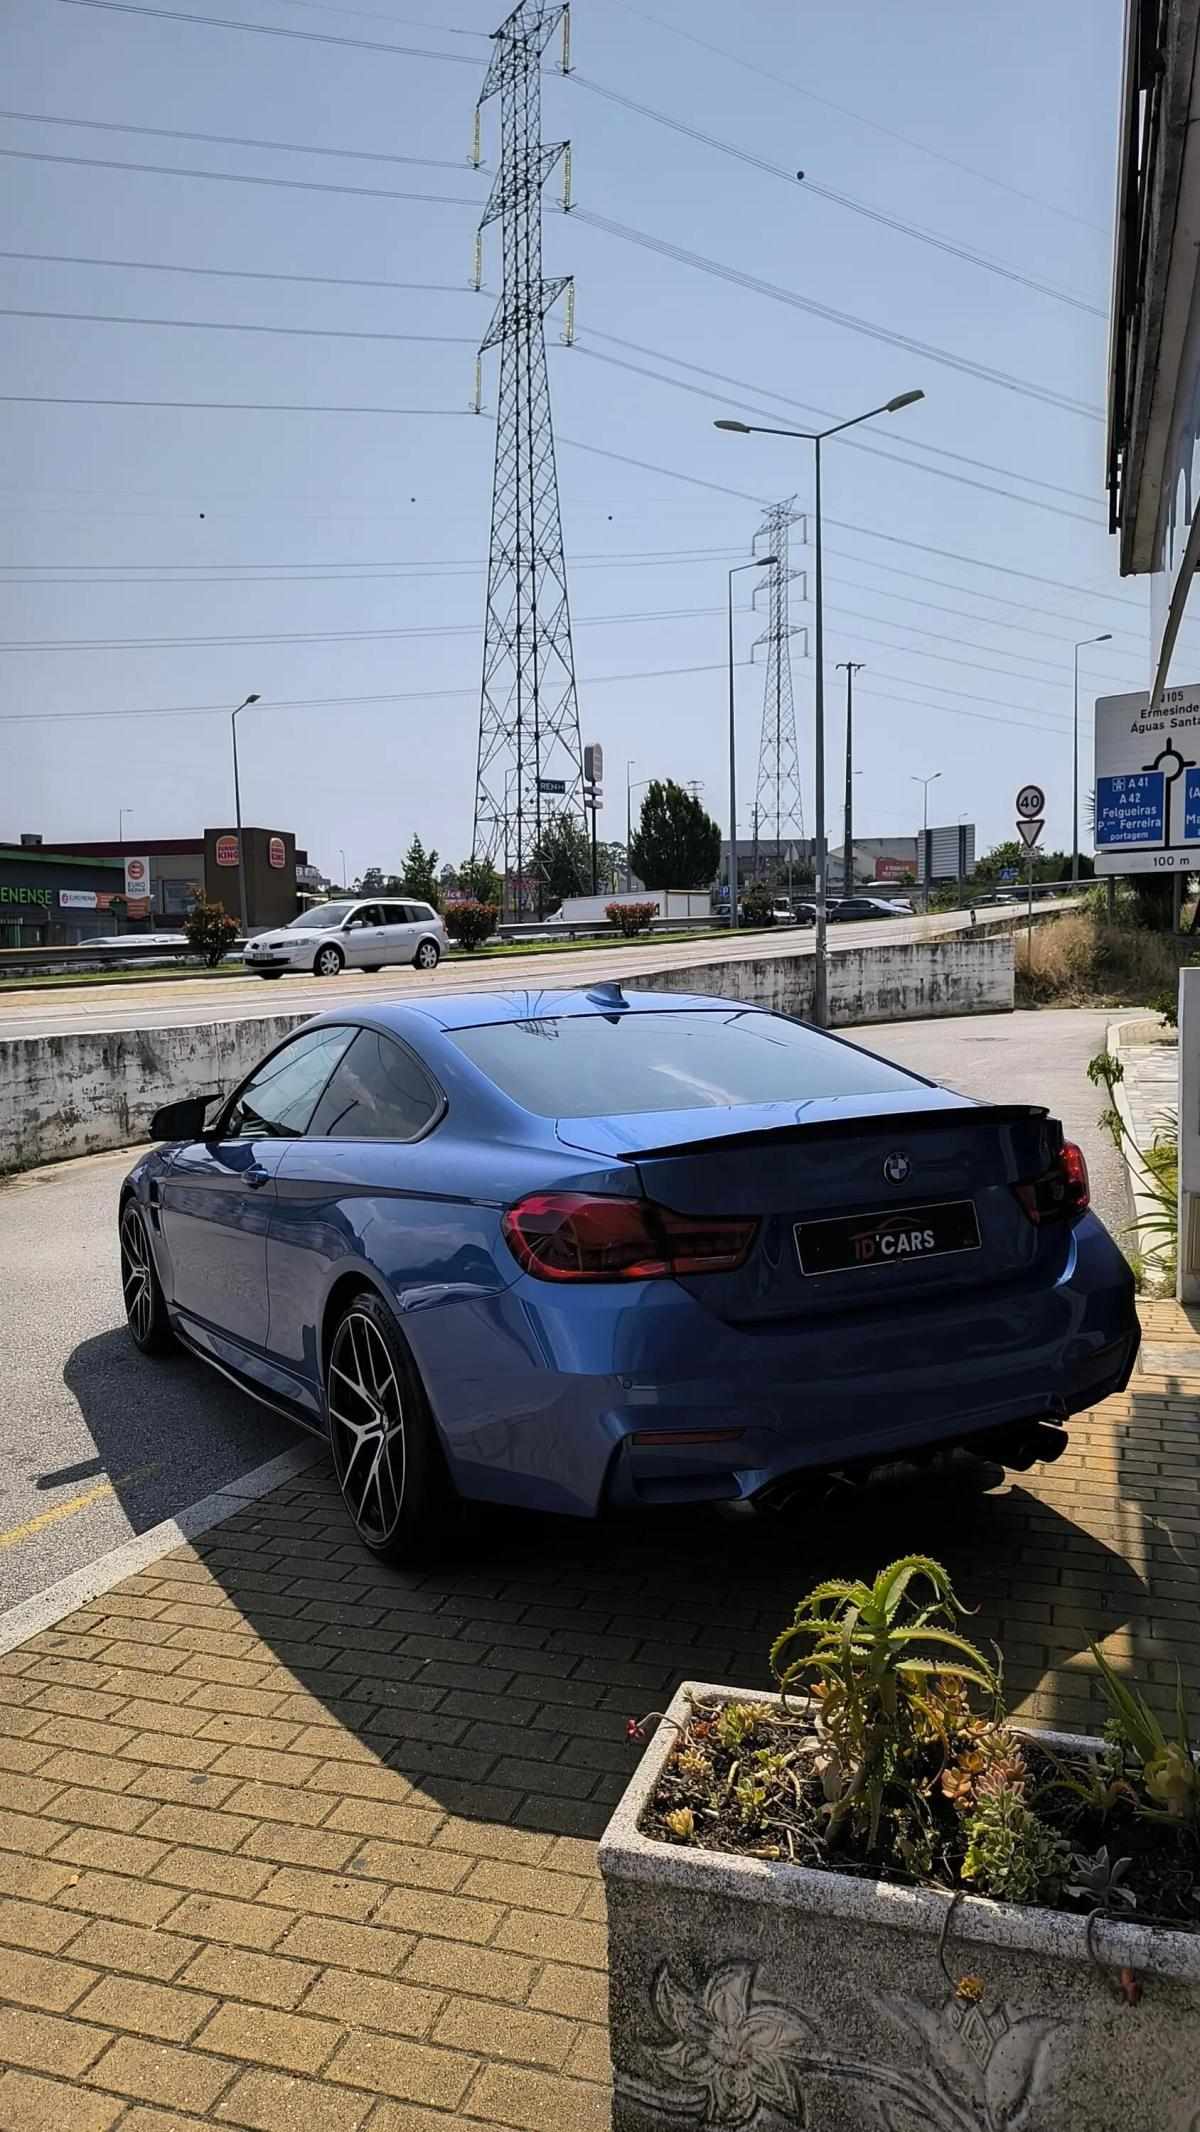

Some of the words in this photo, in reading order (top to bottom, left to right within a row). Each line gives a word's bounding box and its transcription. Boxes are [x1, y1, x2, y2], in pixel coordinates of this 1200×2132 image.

[1140, 703, 1199, 719] Ermesinde
[1130, 719, 1165, 734] Águas
[1020, 795, 1040, 808] 40
[1103, 805, 1157, 819] Felgueiras
[1120, 818, 1161, 829] Ferreira
[1110, 831, 1149, 840] portagem
[1153, 856, 1174, 866] 100
[1180, 857, 1190, 865] m
[0, 887, 53, 905] ENENSE
